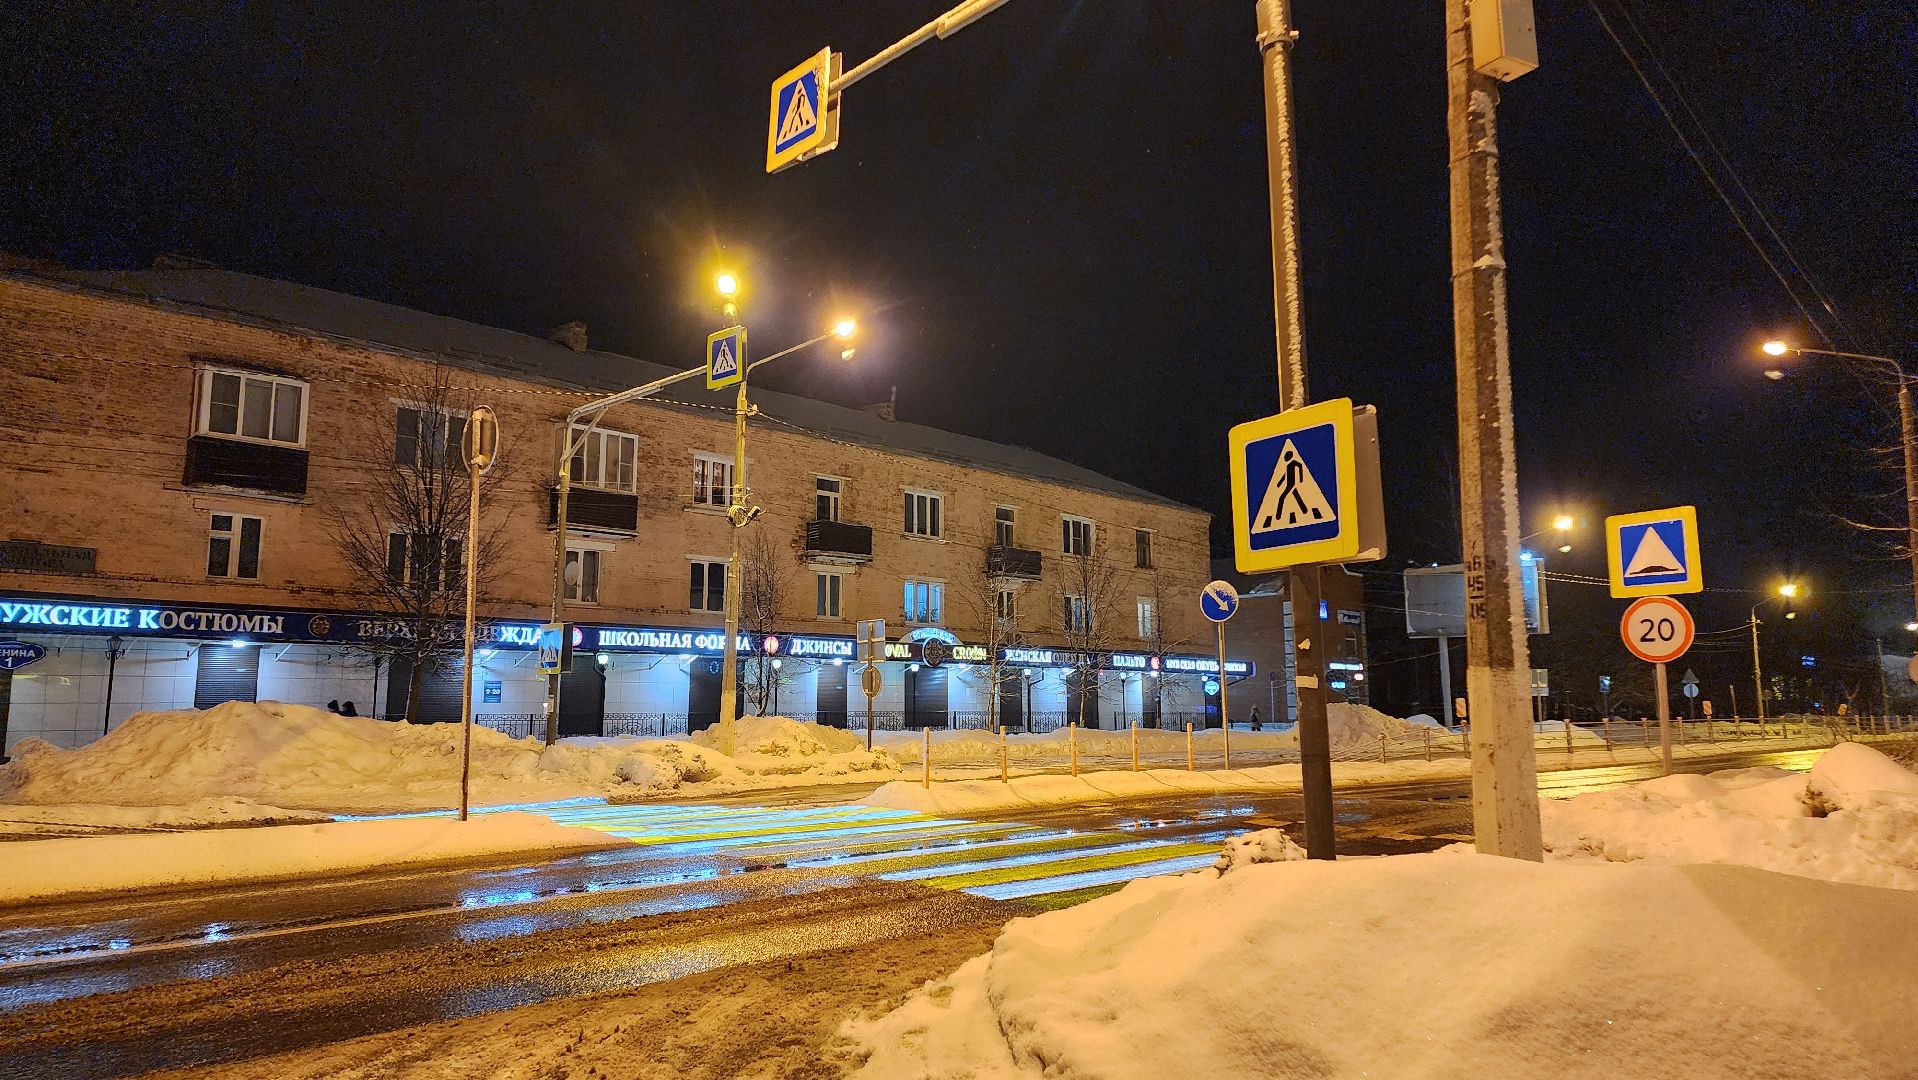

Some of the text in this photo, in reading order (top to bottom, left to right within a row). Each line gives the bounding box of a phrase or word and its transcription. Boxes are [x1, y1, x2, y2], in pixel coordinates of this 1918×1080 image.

[0, 602, 284, 634] УЖСКИЕ КОСТЮМЫ
[1640, 618, 1675, 642] 20
[598, 630, 692, 648] ШКОЛЬНАЯ
[791, 638, 853, 656] ДЖИНСЫ
[953, 645, 987, 661] CROWN
[1005, 649, 1052, 664] ЖЕНСКАЯ
[1113, 655, 1146, 668] ПАЛЬТО
[5, 656, 12, 668] 1
